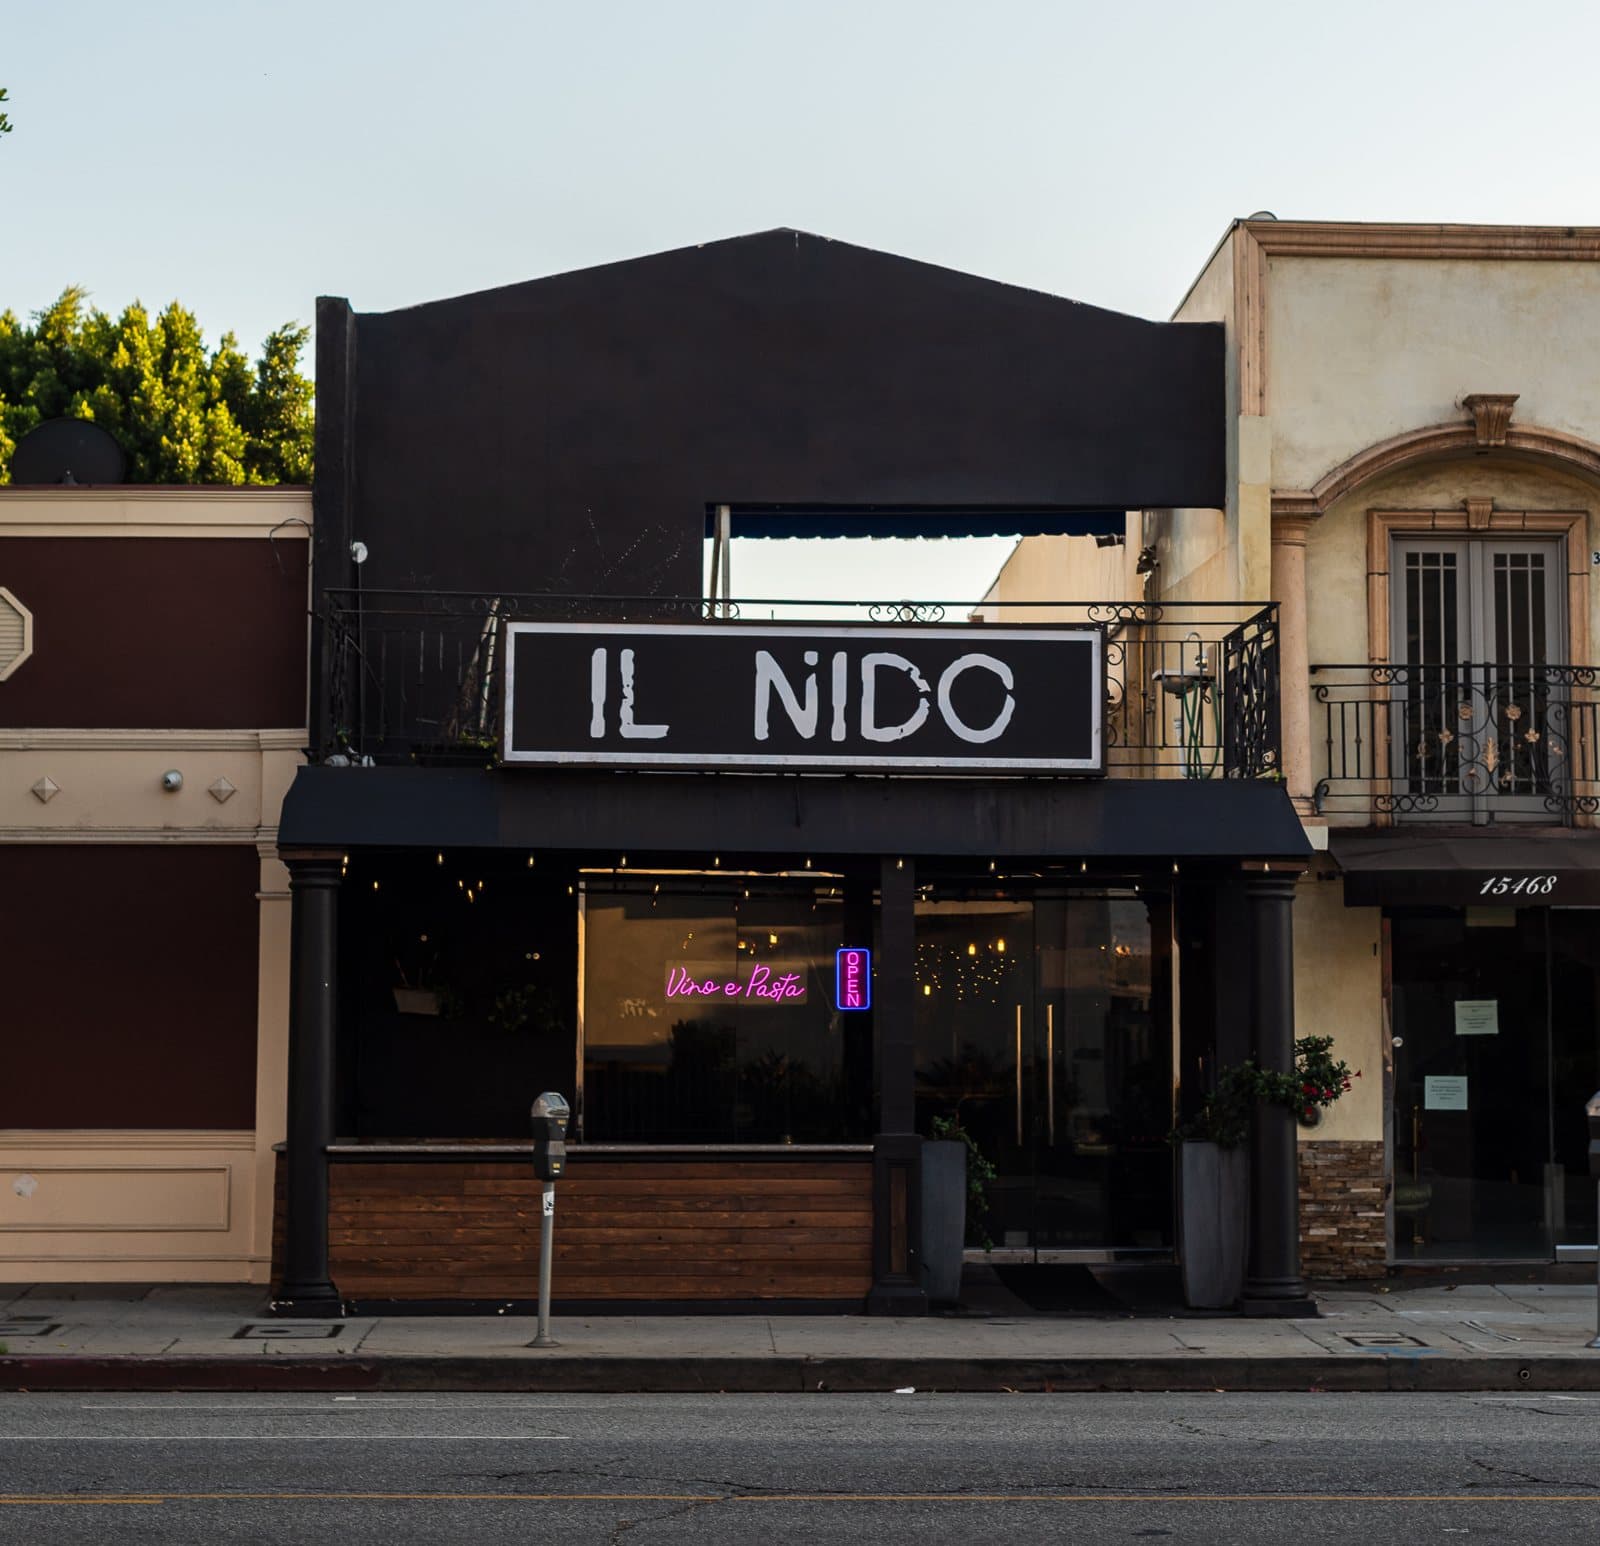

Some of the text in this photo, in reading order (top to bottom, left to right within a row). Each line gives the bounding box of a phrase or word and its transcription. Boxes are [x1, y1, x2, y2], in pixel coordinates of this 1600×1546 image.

[590, 648, 1015, 743] IL NIDO
[1480, 875, 1557, 895] 15468
[666, 964, 805, 1002] Vino e Pasta
[847, 951, 859, 1007] OPEN
